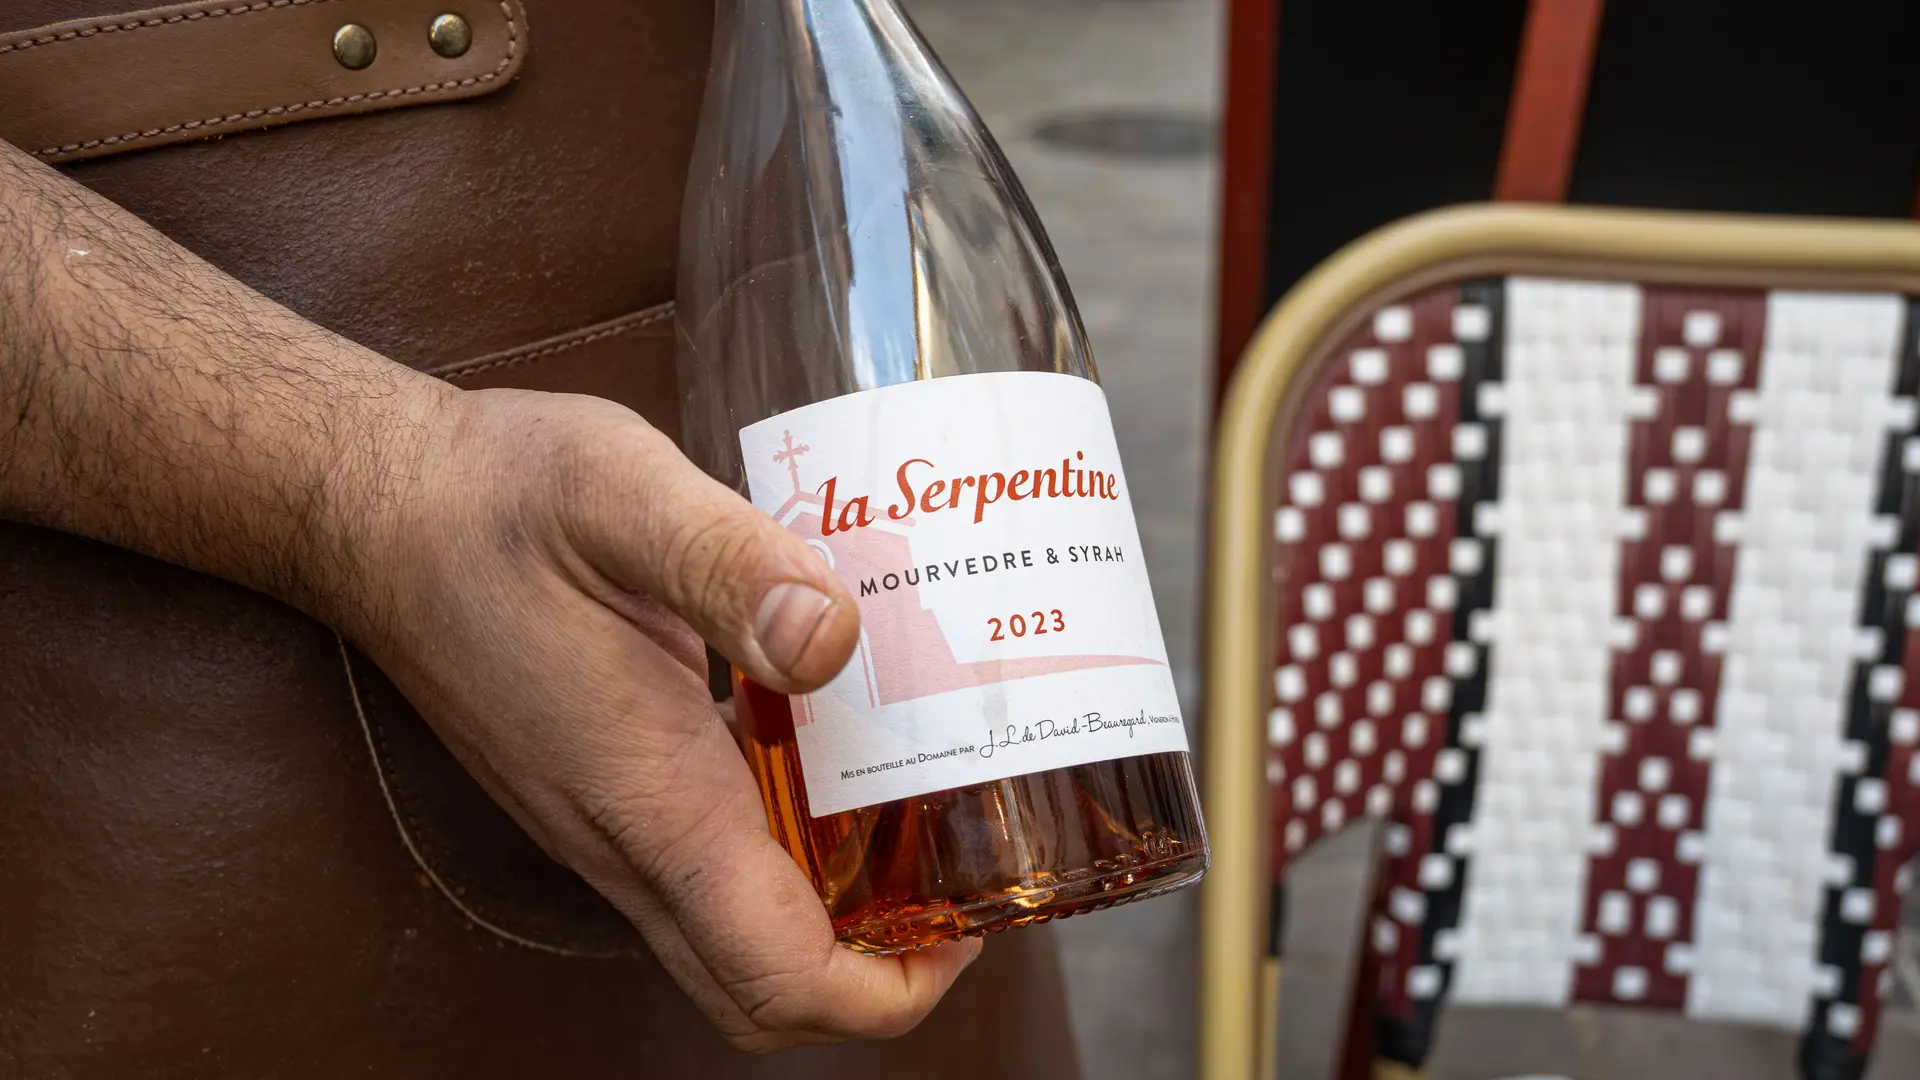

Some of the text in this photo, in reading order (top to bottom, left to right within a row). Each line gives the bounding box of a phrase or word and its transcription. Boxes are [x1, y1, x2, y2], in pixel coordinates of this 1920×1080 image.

[816, 450, 1119, 537] la Serpentine
[859, 545, 1125, 597] MOURVEDRE & SYRAH
[986, 608, 1066, 642] 2023
[856, 768, 866, 777] EN
[866, 759, 904, 775] BOUTEILLE
[905, 757, 917, 766] AU
[959, 745, 975, 756] PAR
